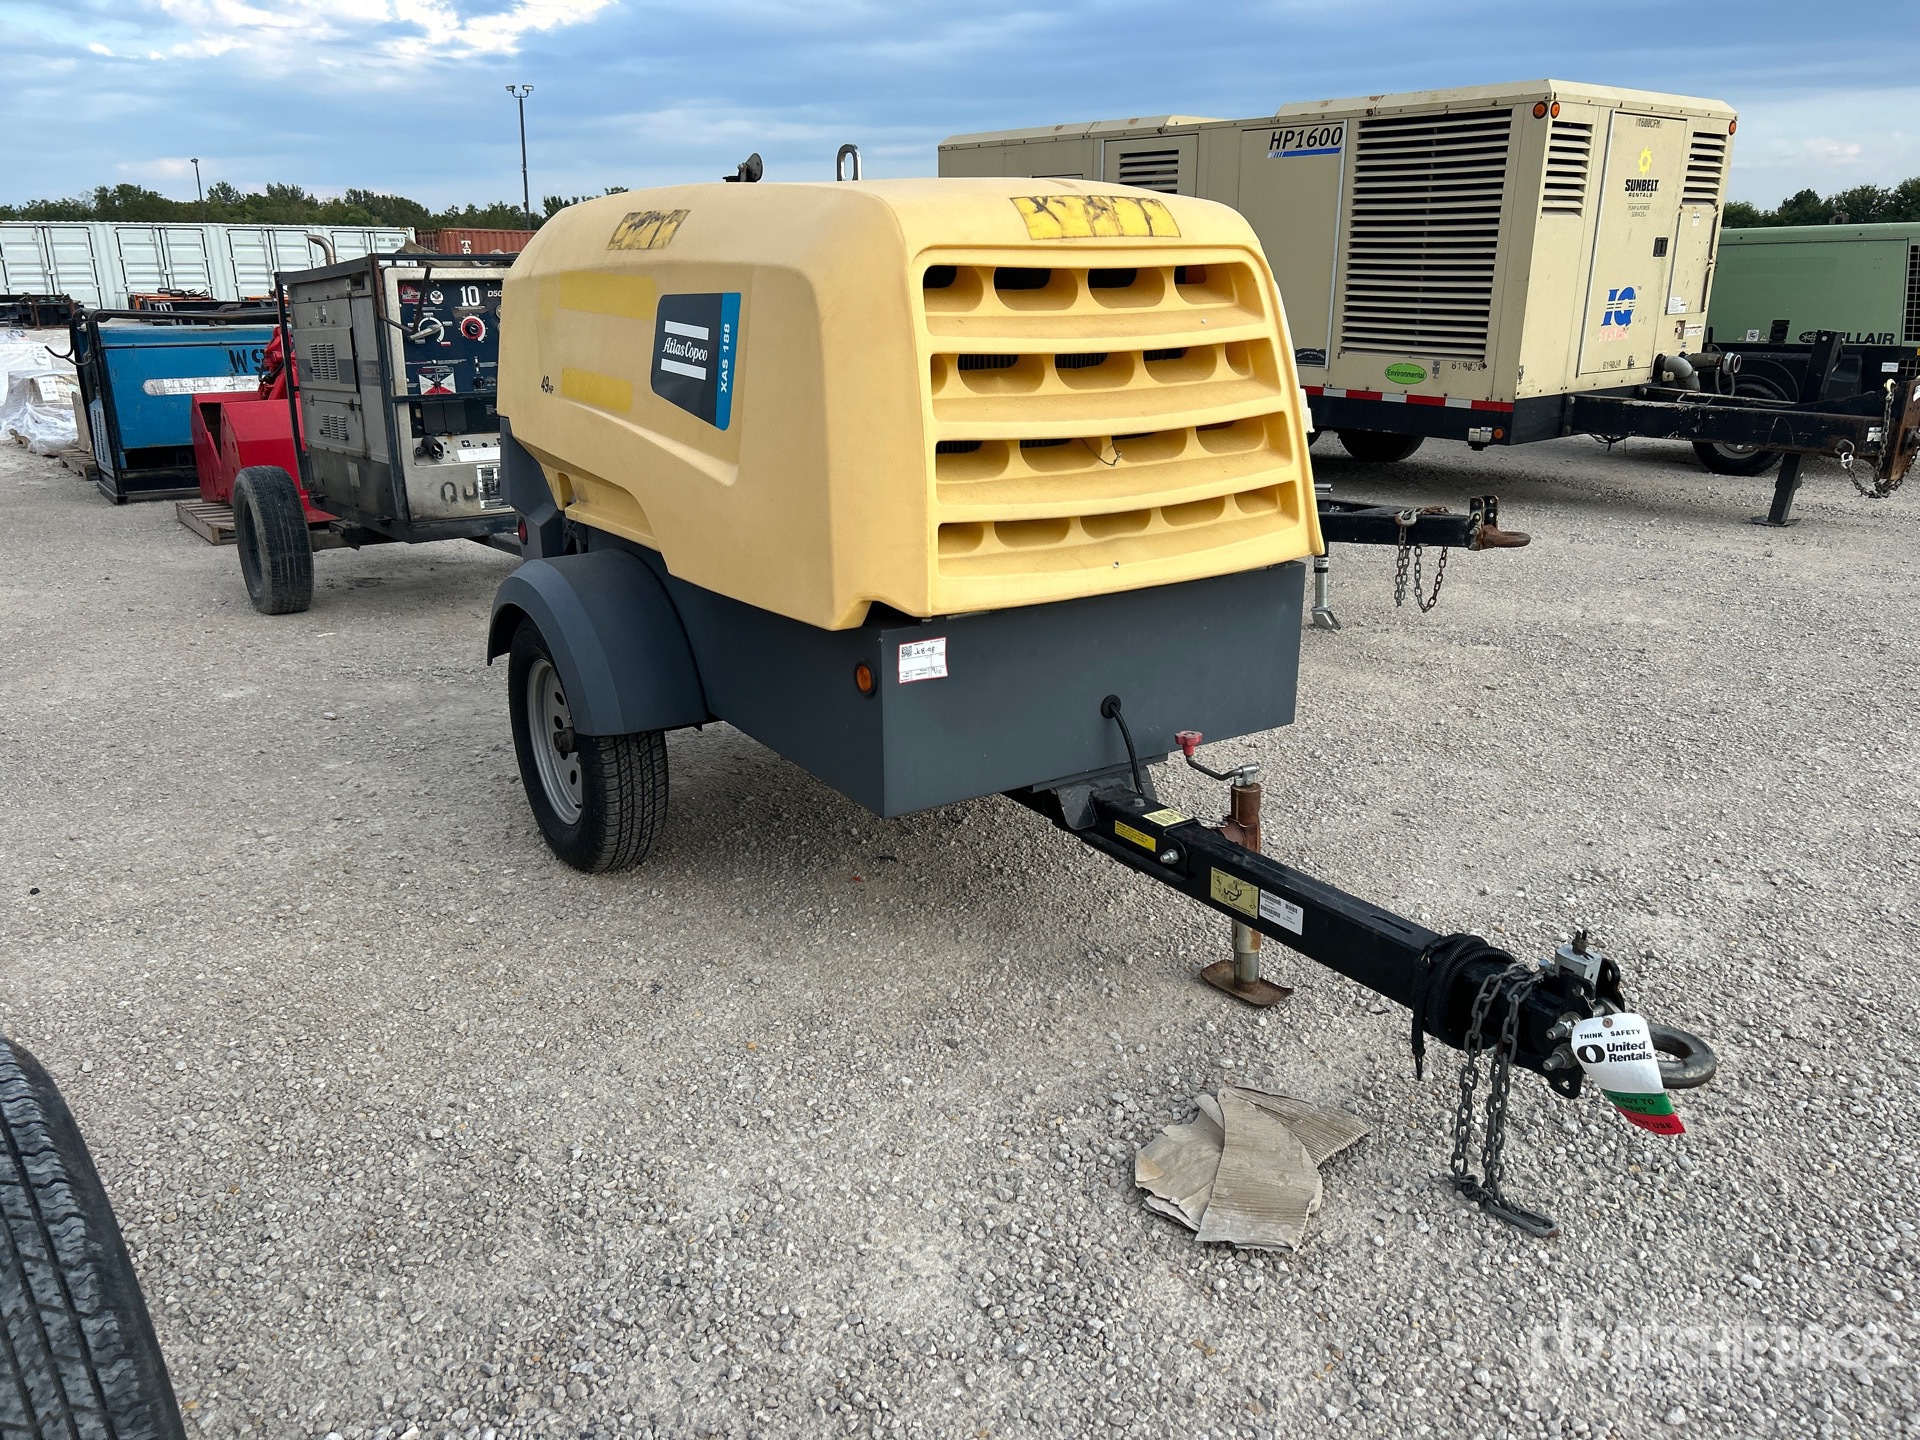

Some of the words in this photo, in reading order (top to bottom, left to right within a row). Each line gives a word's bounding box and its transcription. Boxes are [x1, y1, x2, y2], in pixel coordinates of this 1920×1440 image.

[1269, 126, 1343, 150] HP1600
[1625, 179, 1659, 192] SUNBELT
[460, 285, 480, 307] 10
[1601, 286, 1636, 327] IQ
[722, 323, 731, 352] 188
[1845, 332, 1896, 345] LLAIR
[662, 337, 685, 357] Atlas
[684, 340, 708, 362] Copco
[720, 358, 729, 393] XAS
[1386, 369, 1425, 379] Environmental
[163, 378, 180, 388] Big
[182, 378, 204, 387] Blue
[1579, 1032, 1603, 1040] THINK
[1610, 1029, 1641, 1037] SAFETY
[1606, 1041, 1646, 1052] United
[1608, 1051, 1652, 1062] Rentals
[1652, 1121, 1673, 1129] USE
